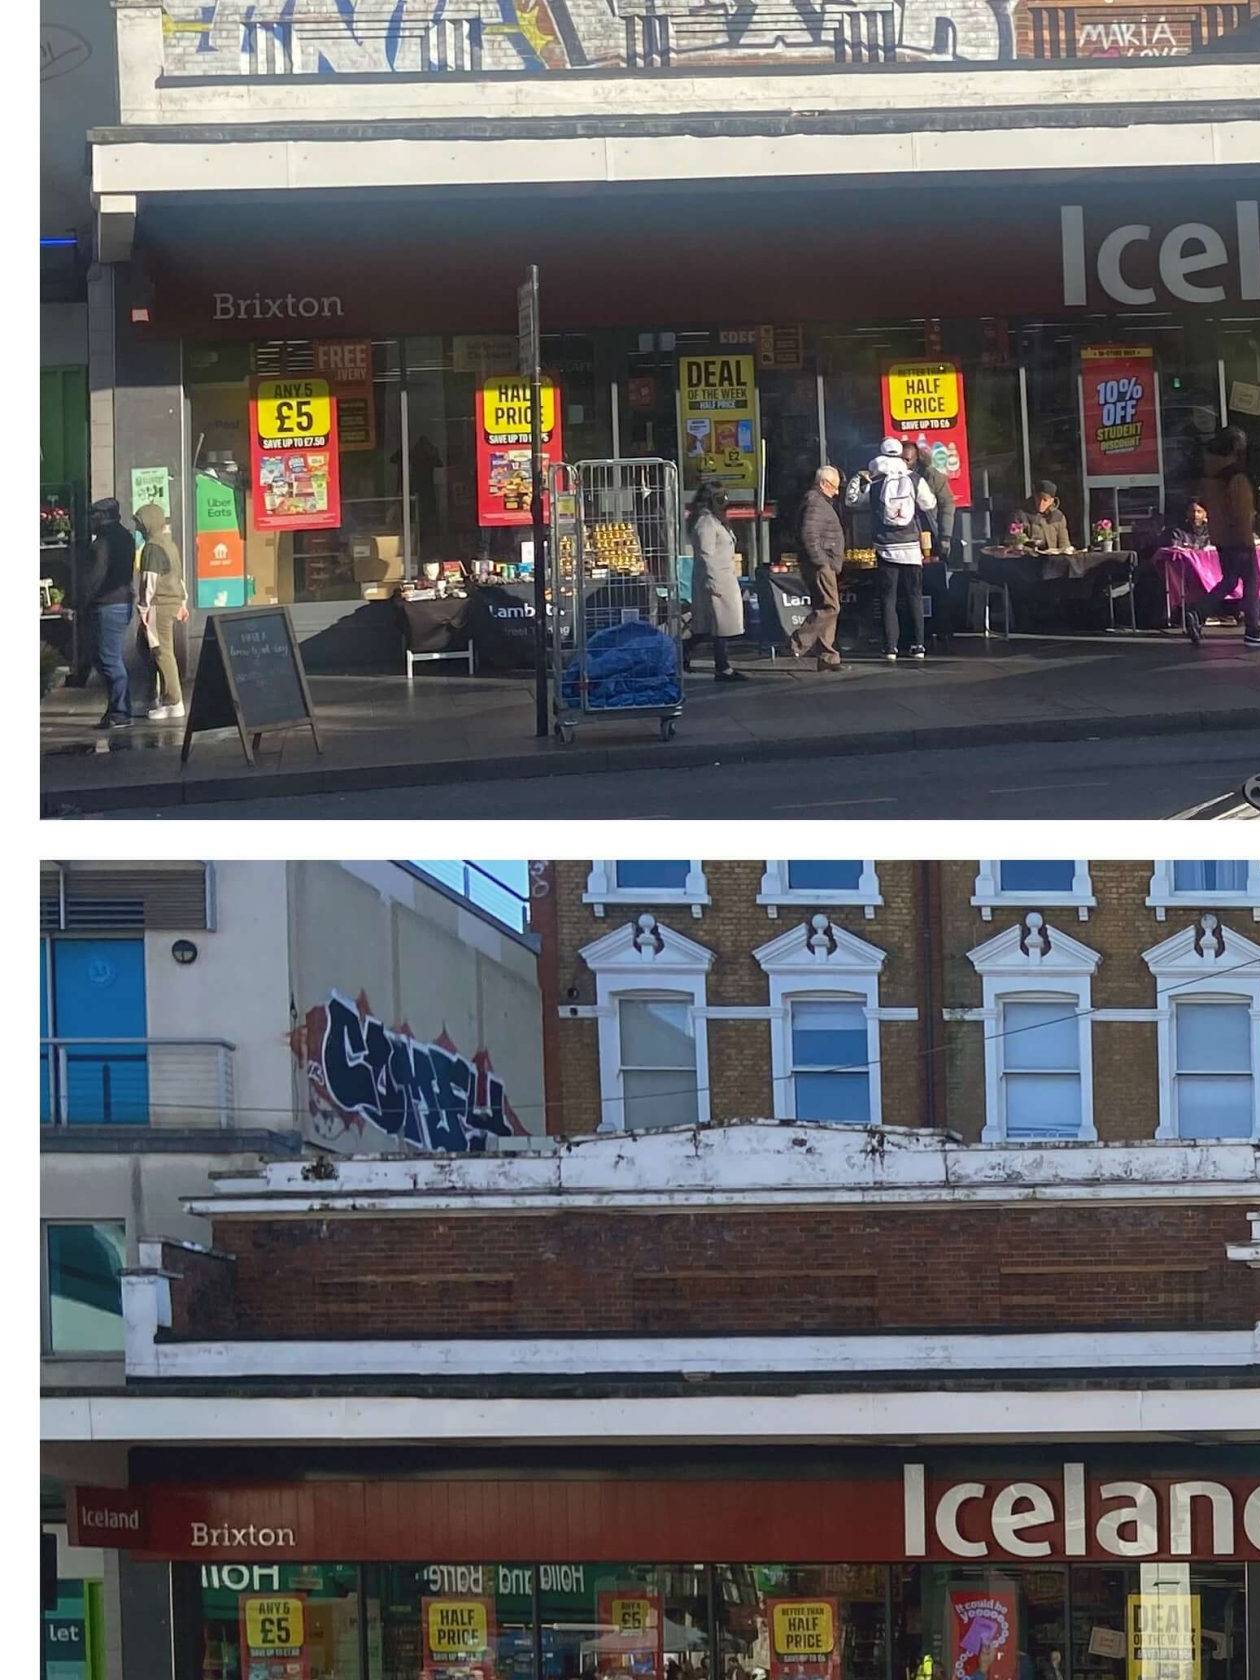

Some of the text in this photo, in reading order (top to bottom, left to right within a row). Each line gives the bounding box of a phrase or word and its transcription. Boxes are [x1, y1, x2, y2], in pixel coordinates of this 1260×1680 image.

[212, 291, 345, 322] Brixton
[318, 346, 367, 369] FREE
[686, 360, 748, 388] DEAL
[274, 383, 313, 398] ANY 5
[499, 385, 534, 402] HAL
[688, 388, 748, 400] OF THE WEEK
[906, 378, 941, 395] HALF
[1097, 377, 1143, 404] 10%
[904, 397, 945, 414] PRICE
[1102, 400, 1137, 426] OFF
[275, 400, 314, 433] £5
[901, 421, 919, 430] SAVE
[919, 420, 930, 429] UP
[930, 420, 939, 428] TO
[488, 434, 507, 444] SAVE
[508, 434, 519, 443] UP
[1096, 421, 1143, 441] STUDENT
[263, 438, 282, 449] SAVE
[283, 438, 294, 448] UP
[295, 437, 304, 447] TO
[207, 498, 232, 508] Uber
[207, 508, 232, 518] Eats
[81, 1507, 141, 1532] Iceland
[190, 1523, 297, 1548] Brixton
[259, 1602, 281, 1615] ANY
[965, 1599, 994, 1610] could
[440, 1608, 475, 1627] HALF
[788, 1617, 819, 1632] HALF
[1133, 1604, 1196, 1633] DEAL
[49, 1623, 80, 1642] let
[260, 1616, 291, 1644] £5
[437, 1628, 479, 1646] PRICE
[786, 1633, 823, 1650] PRICE
